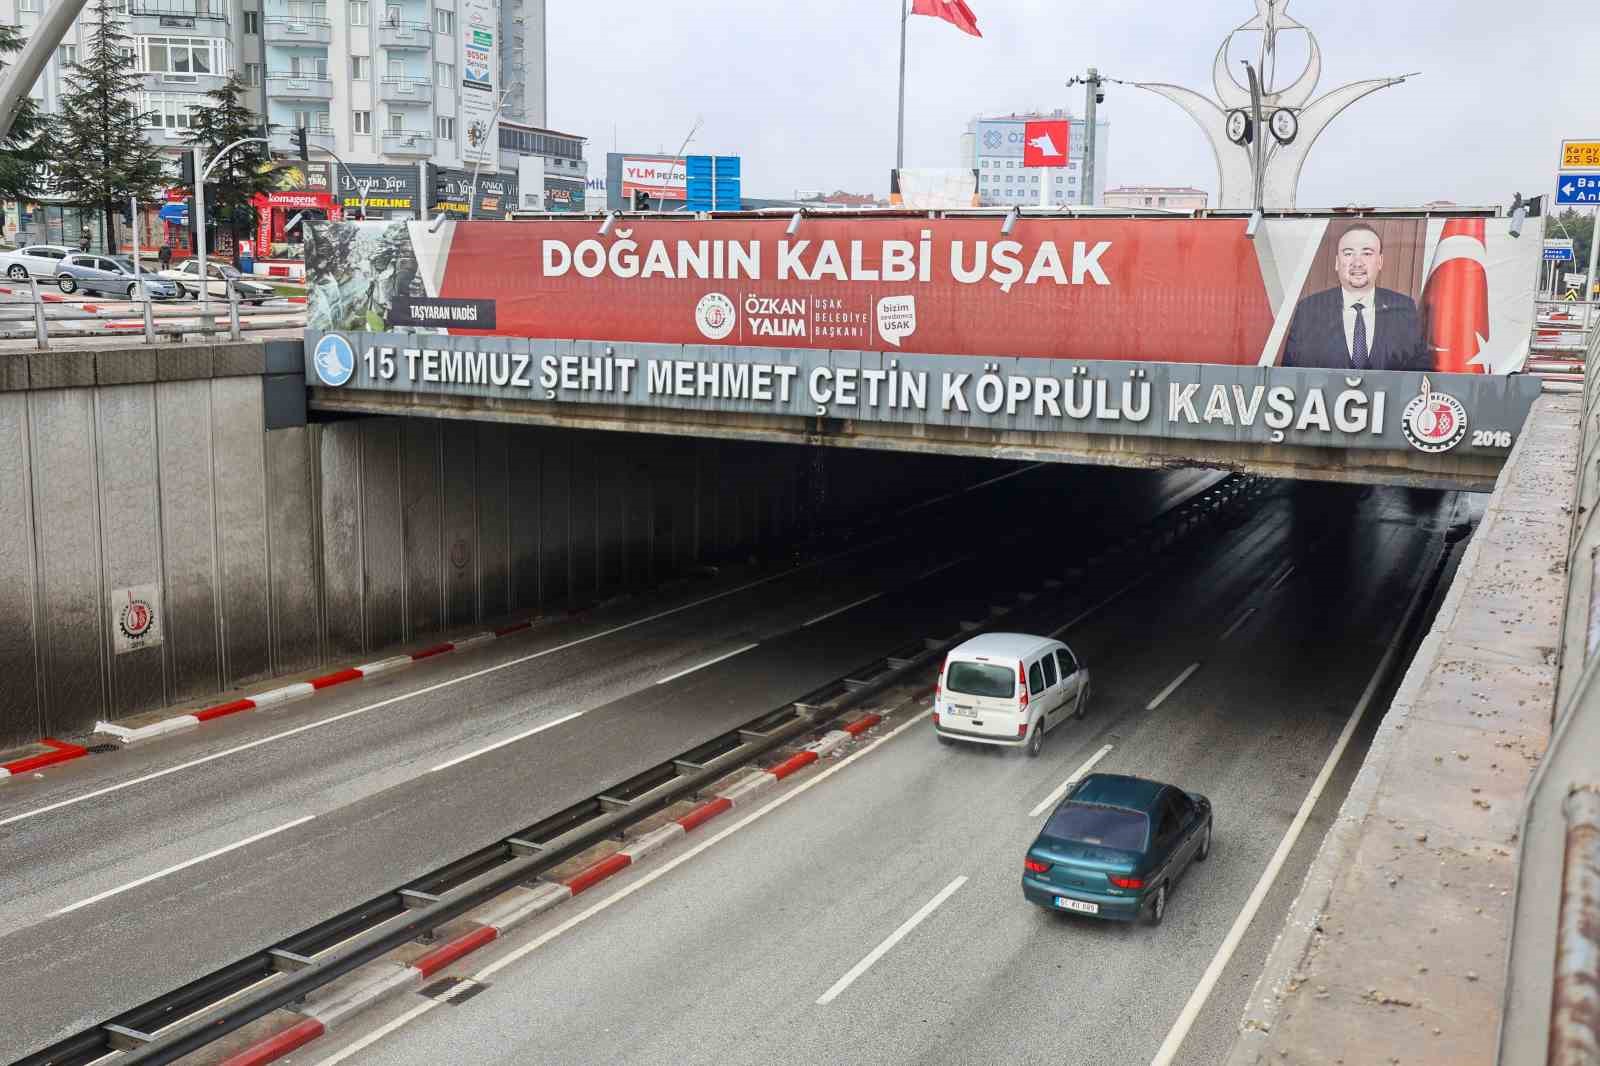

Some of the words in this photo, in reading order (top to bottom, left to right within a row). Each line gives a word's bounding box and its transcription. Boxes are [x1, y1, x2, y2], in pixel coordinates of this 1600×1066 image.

[627, 167, 655, 179] YLM
[1577, 177, 1600, 188] Ba
[268, 193, 317, 204] komagene
[542, 228, 761, 280] DOĞANIN
[777, 229, 932, 282] KALBİ
[950, 240, 1112, 293] UŞAK
[745, 294, 806, 315] ÖZKAN
[883, 303, 909, 313] bizim
[409, 305, 450, 321] TAŞYARAN
[451, 304, 478, 321] VADİSİ
[815, 311, 868, 324] BELEDİYE
[748, 318, 807, 337] YALIM
[815, 326, 864, 338] BAŞKANI
[364, 347, 395, 380] 15
[403, 348, 531, 387] TEMMUZ
[540, 347, 637, 400] ŞEHİT
[648, 359, 798, 402] MEHMET
[809, 359, 927, 416] ÇETİN
[942, 360, 1151, 422] KÖPRÜLÜ
[1168, 377, 1386, 443] KAVŞAĞI
[1472, 430, 1512, 447] 2016
